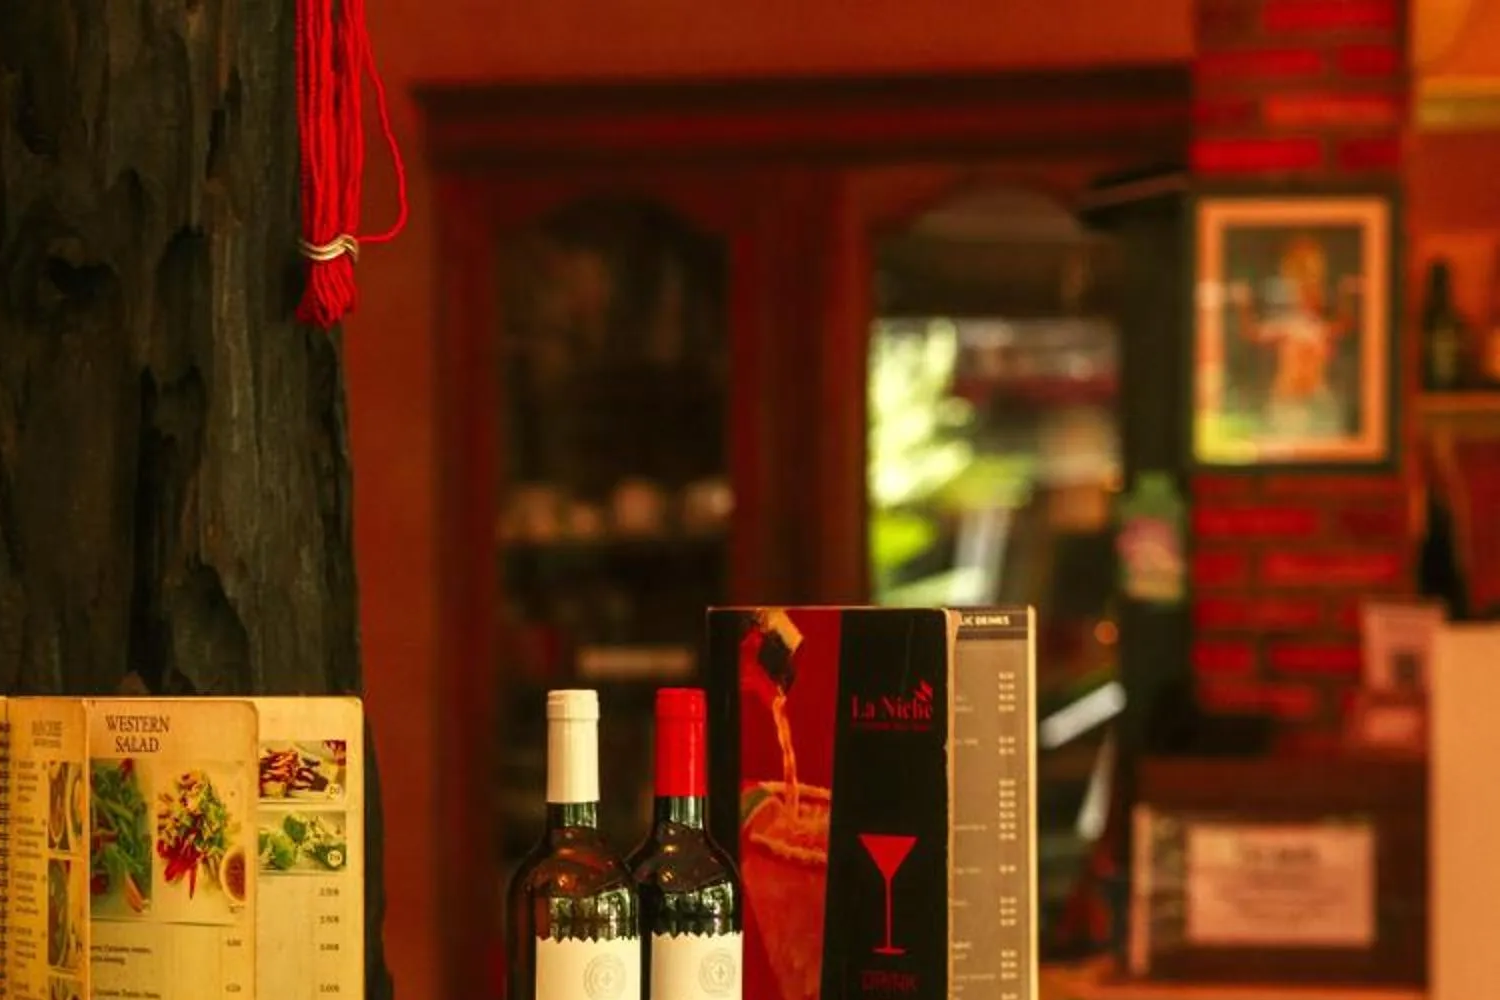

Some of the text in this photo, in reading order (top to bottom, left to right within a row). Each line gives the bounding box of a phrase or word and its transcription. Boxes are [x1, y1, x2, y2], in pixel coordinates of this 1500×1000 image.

[851, 694, 875, 720] La
[105, 714, 170, 733] WESTERN
[115, 735, 161, 753] SALAD
[861, 971, 919, 991] DRINK
